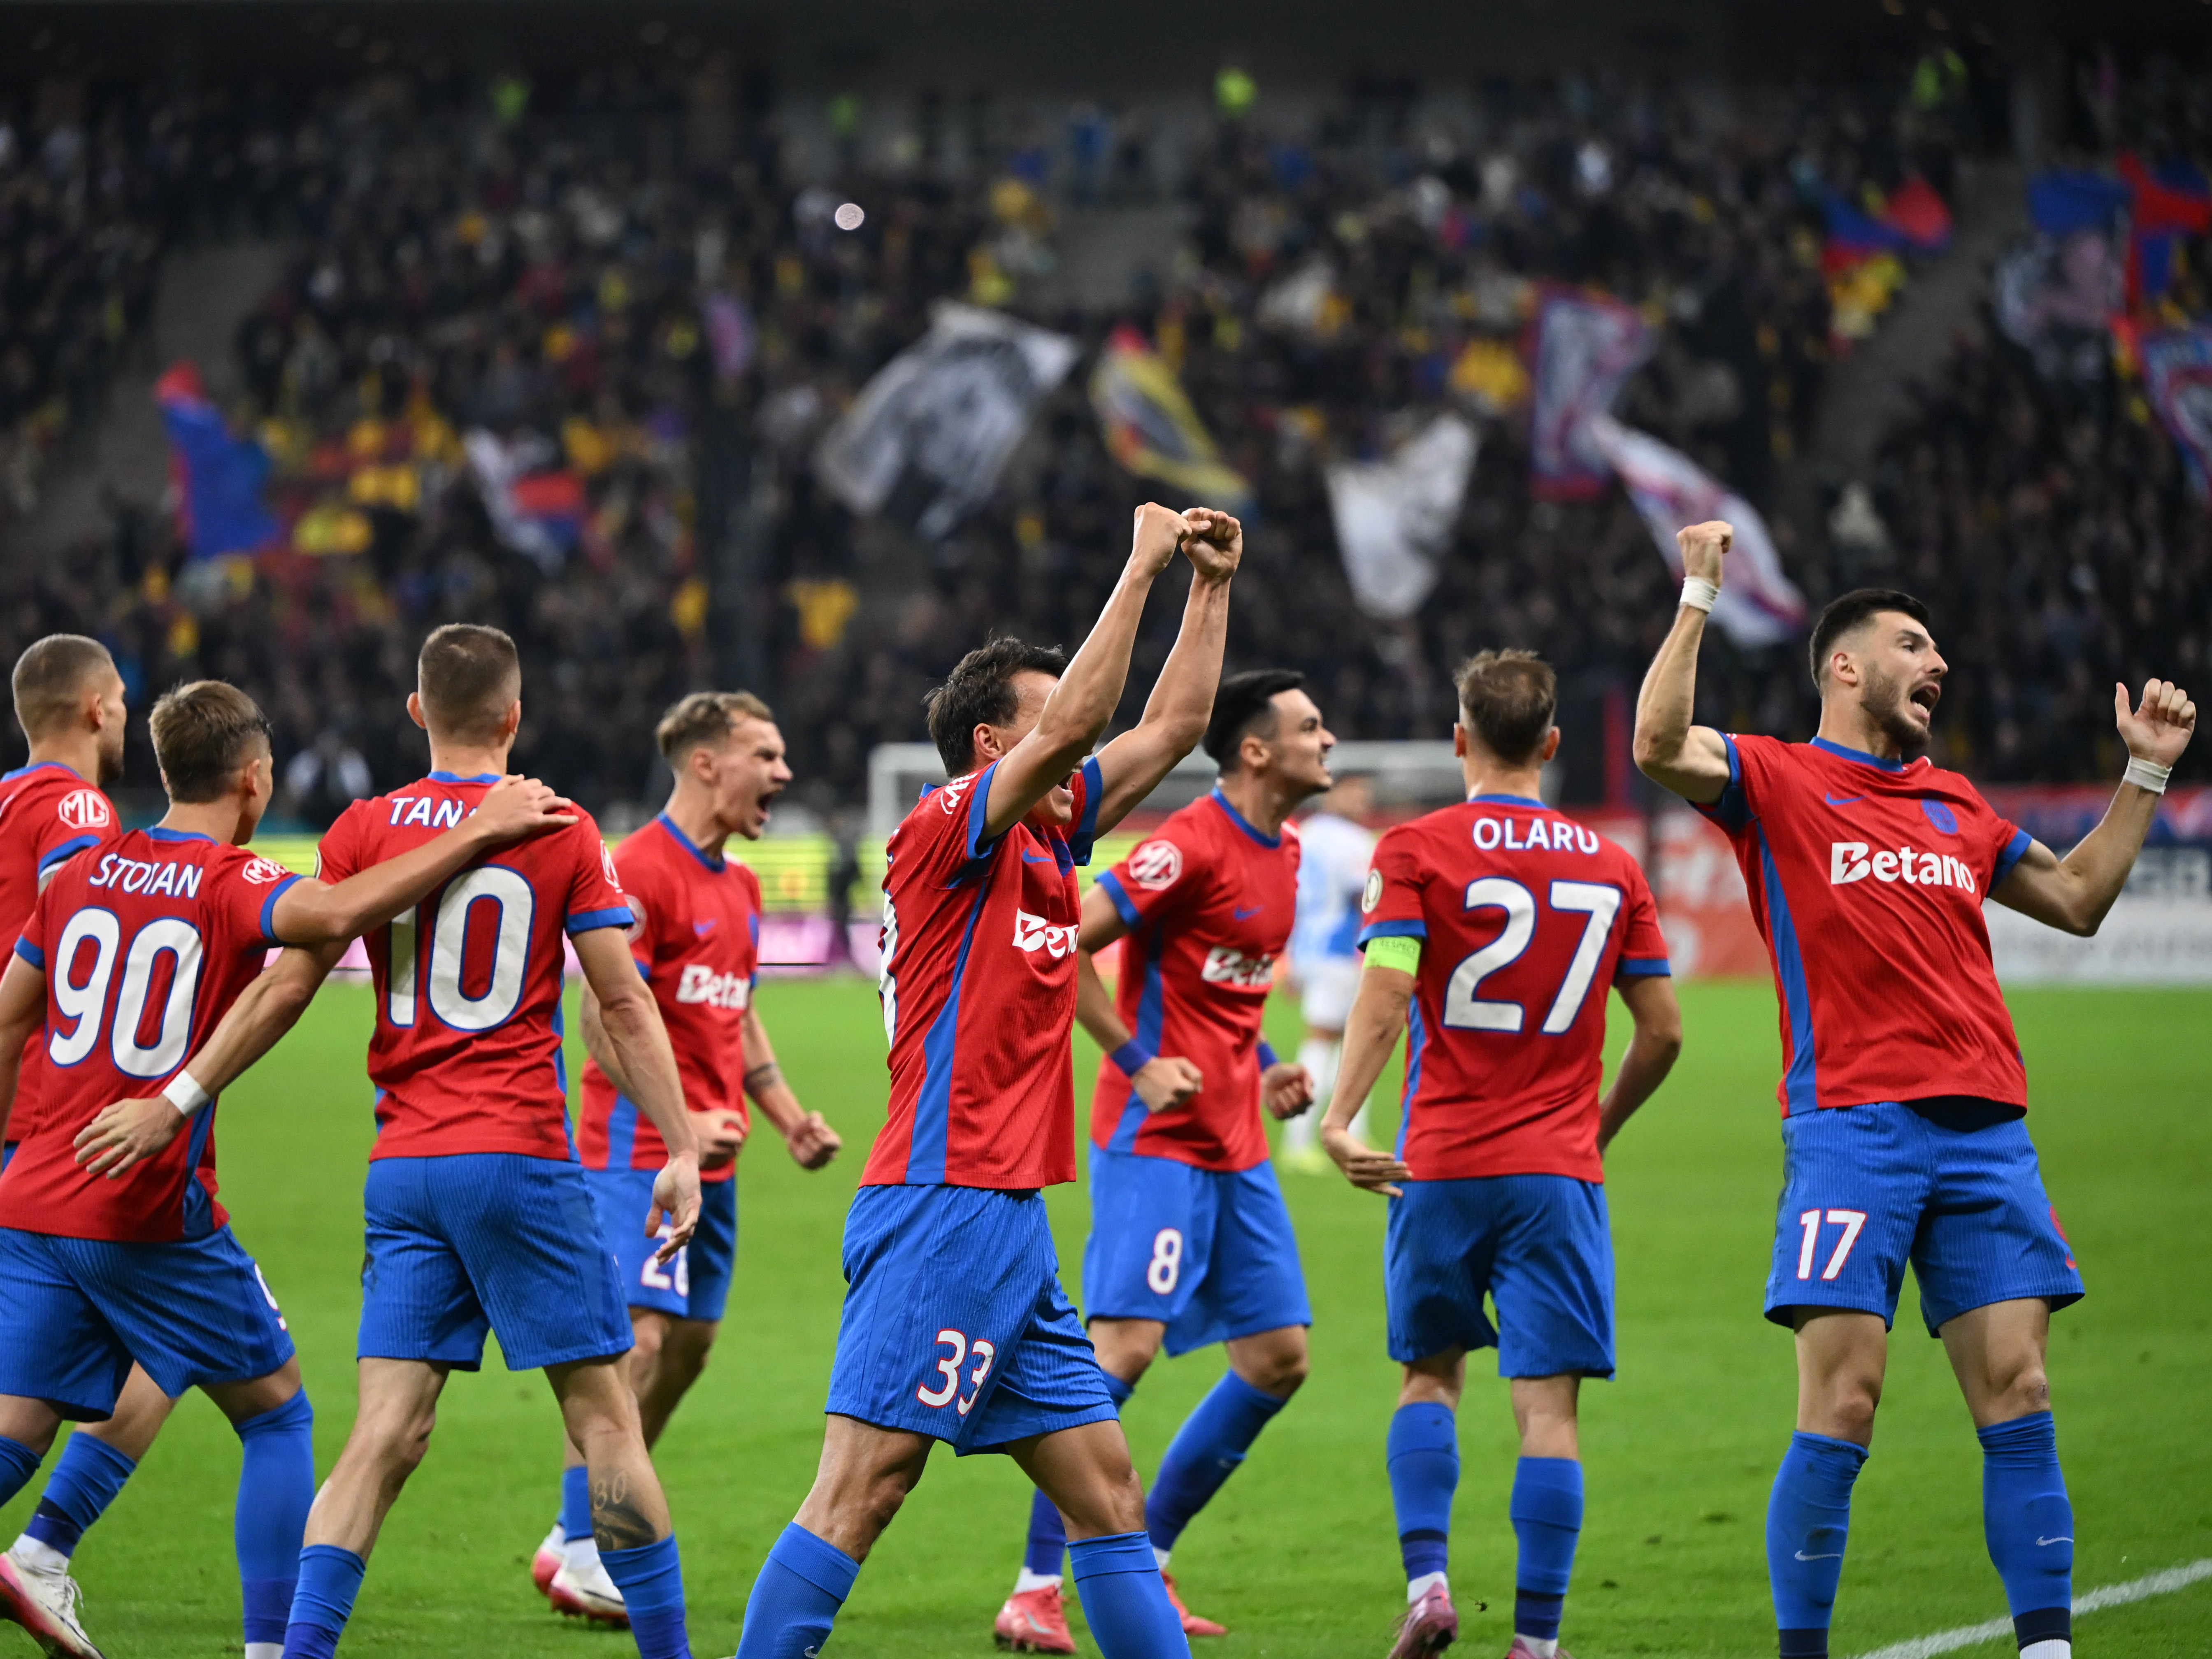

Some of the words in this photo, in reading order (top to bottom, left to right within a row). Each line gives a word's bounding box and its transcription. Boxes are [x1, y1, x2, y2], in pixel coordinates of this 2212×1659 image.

[62, 791, 107, 824] MG
[389, 796, 477, 829] TAN
[1472, 817, 1600, 855] OLARU
[88, 852, 204, 899] STOIAN
[1831, 841, 1975, 894] Betano
[388, 864, 534, 1032] 10
[1442, 876, 1622, 1034] 27
[48, 906, 204, 1079] 90
[1147, 1228, 1183, 1294] 8
[1797, 1209, 1867, 1280] 17
[916, 1328, 995, 1416] 33
